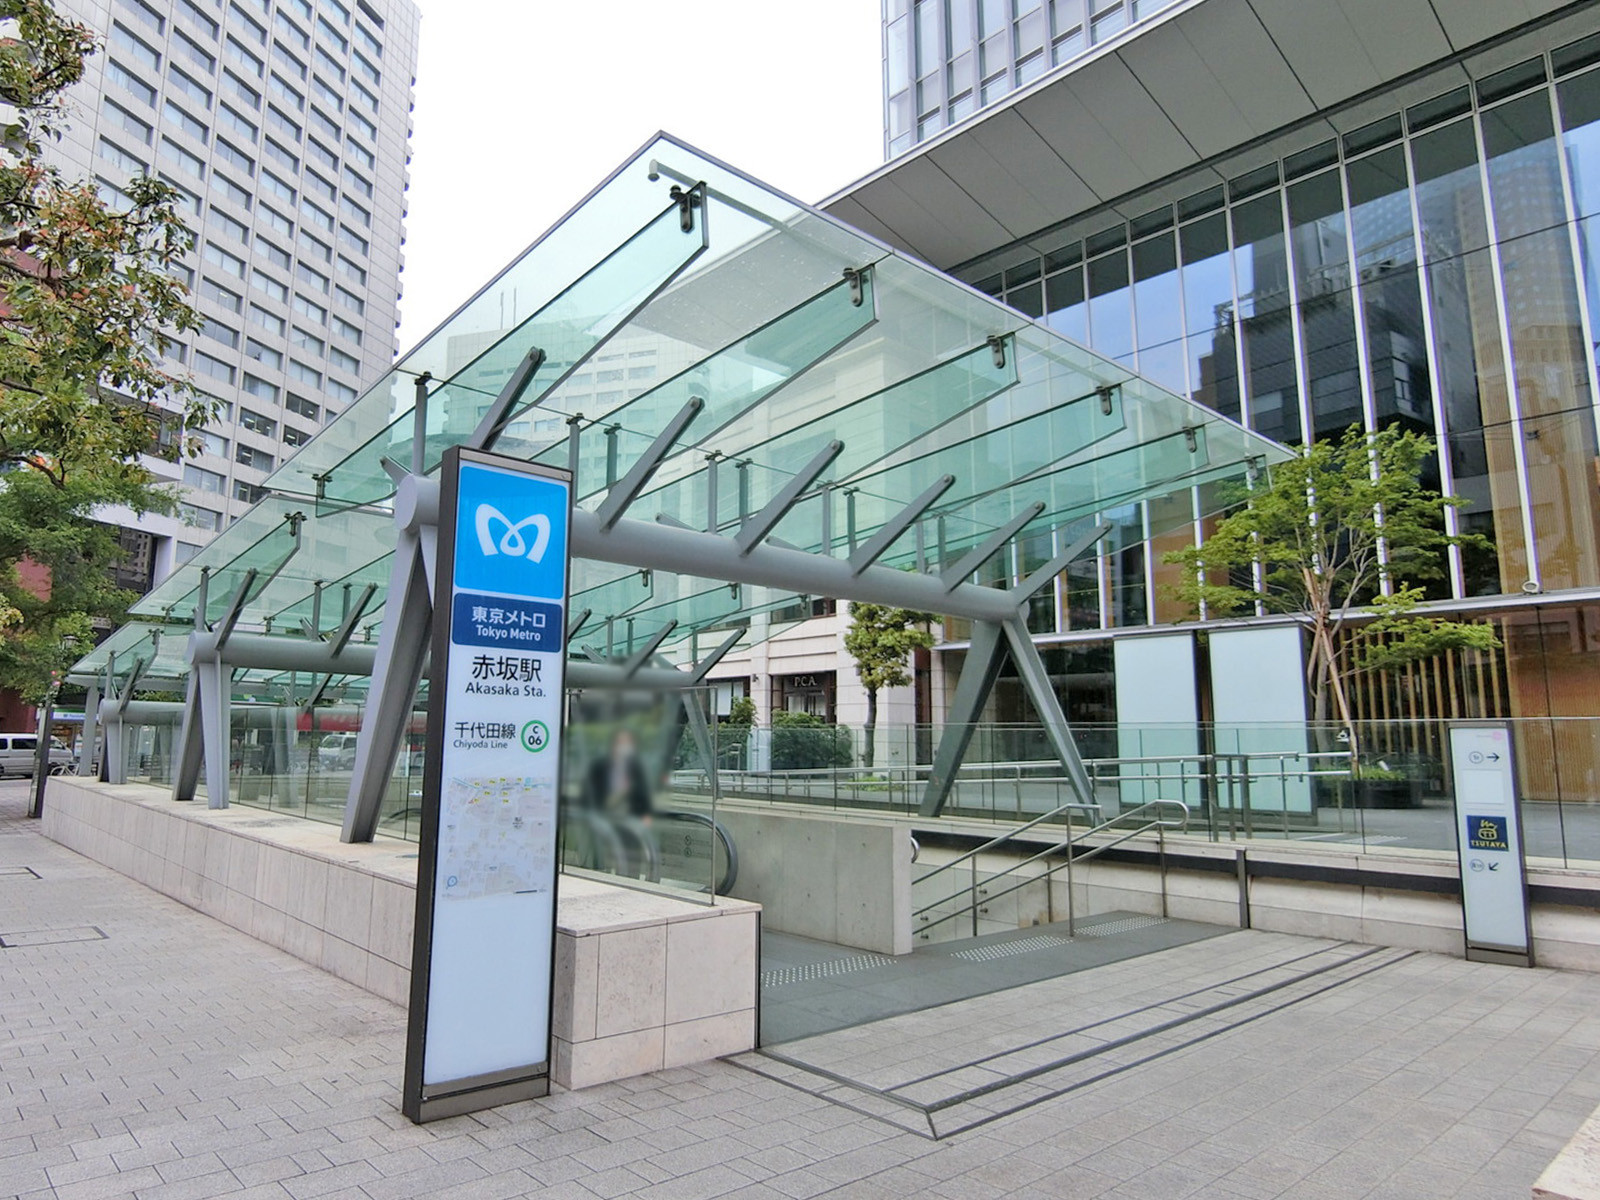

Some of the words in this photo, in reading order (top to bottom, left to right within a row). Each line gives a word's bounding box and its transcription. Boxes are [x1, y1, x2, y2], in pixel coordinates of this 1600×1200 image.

[471, 606, 546, 628] 東京メトロ
[475, 624, 508, 639] Tokyo
[510, 628, 541, 641] Metro
[472, 654, 542, 682] 赤坂駅
[465, 682, 519, 696] Akasaka
[524, 685, 546, 697] Sta.
[454, 721, 516, 740] 千代田線
[532, 725, 539, 734] C
[453, 739, 488, 750] Chiyoda
[491, 740, 508, 749] Line
[528, 735, 542, 745] 06
[1470, 840, 1507, 849] TSUTAYA
